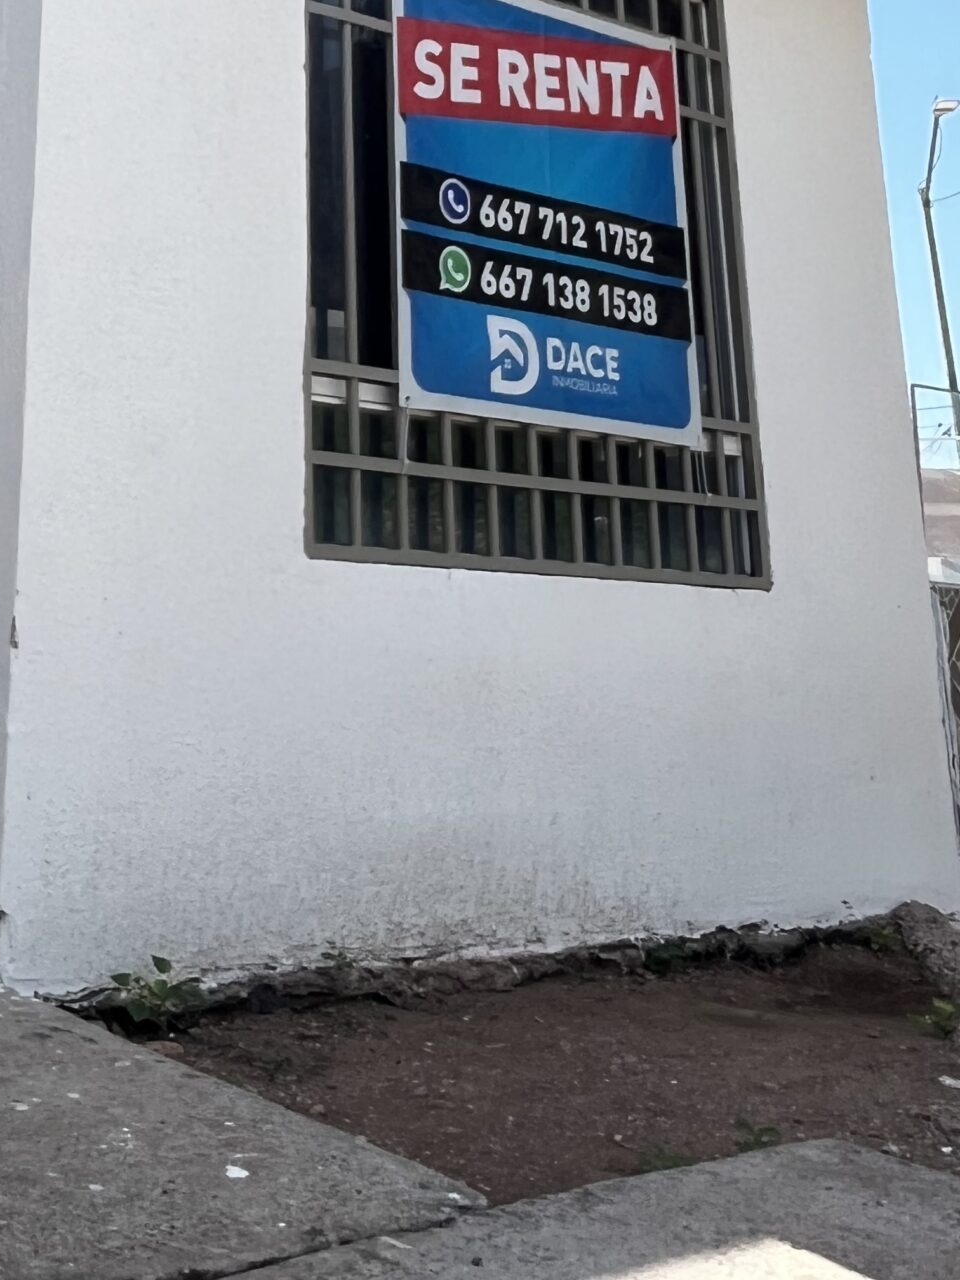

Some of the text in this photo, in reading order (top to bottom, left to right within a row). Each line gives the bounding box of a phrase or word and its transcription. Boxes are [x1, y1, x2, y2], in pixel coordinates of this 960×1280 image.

[413, 38, 664, 121] SE RENTA
[479, 194, 654, 264] 667 712 1752
[480, 261, 658, 326] 667 138 1538
[546, 337, 620, 381] DACE
